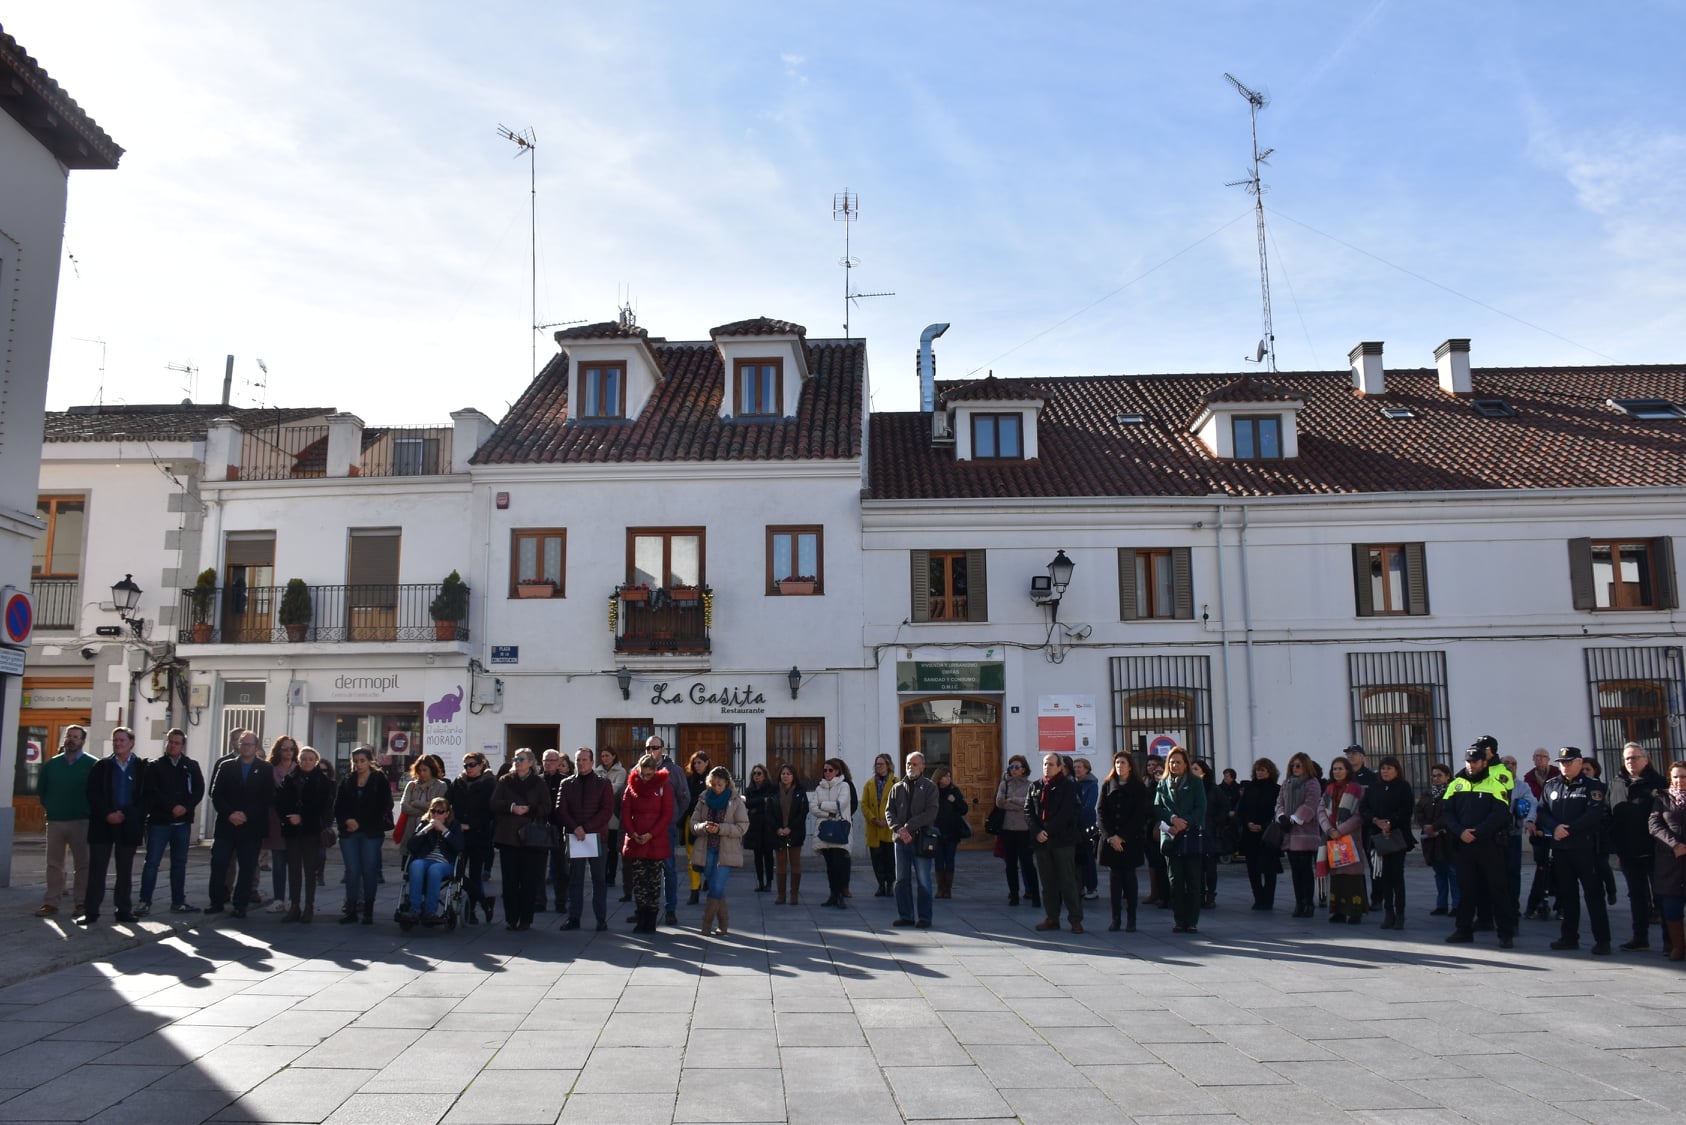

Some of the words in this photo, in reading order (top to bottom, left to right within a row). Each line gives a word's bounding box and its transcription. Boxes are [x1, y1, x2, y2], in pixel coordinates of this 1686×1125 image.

[334, 674, 400, 693] dermopil
[33, 695, 56, 703] Oficina
[67, 695, 92, 703] Turismo
[651, 683, 684, 705] La
[689, 682, 767, 707] Casita
[721, 706, 765, 714] Restaurante
[426, 735, 462, 746] MORADO
